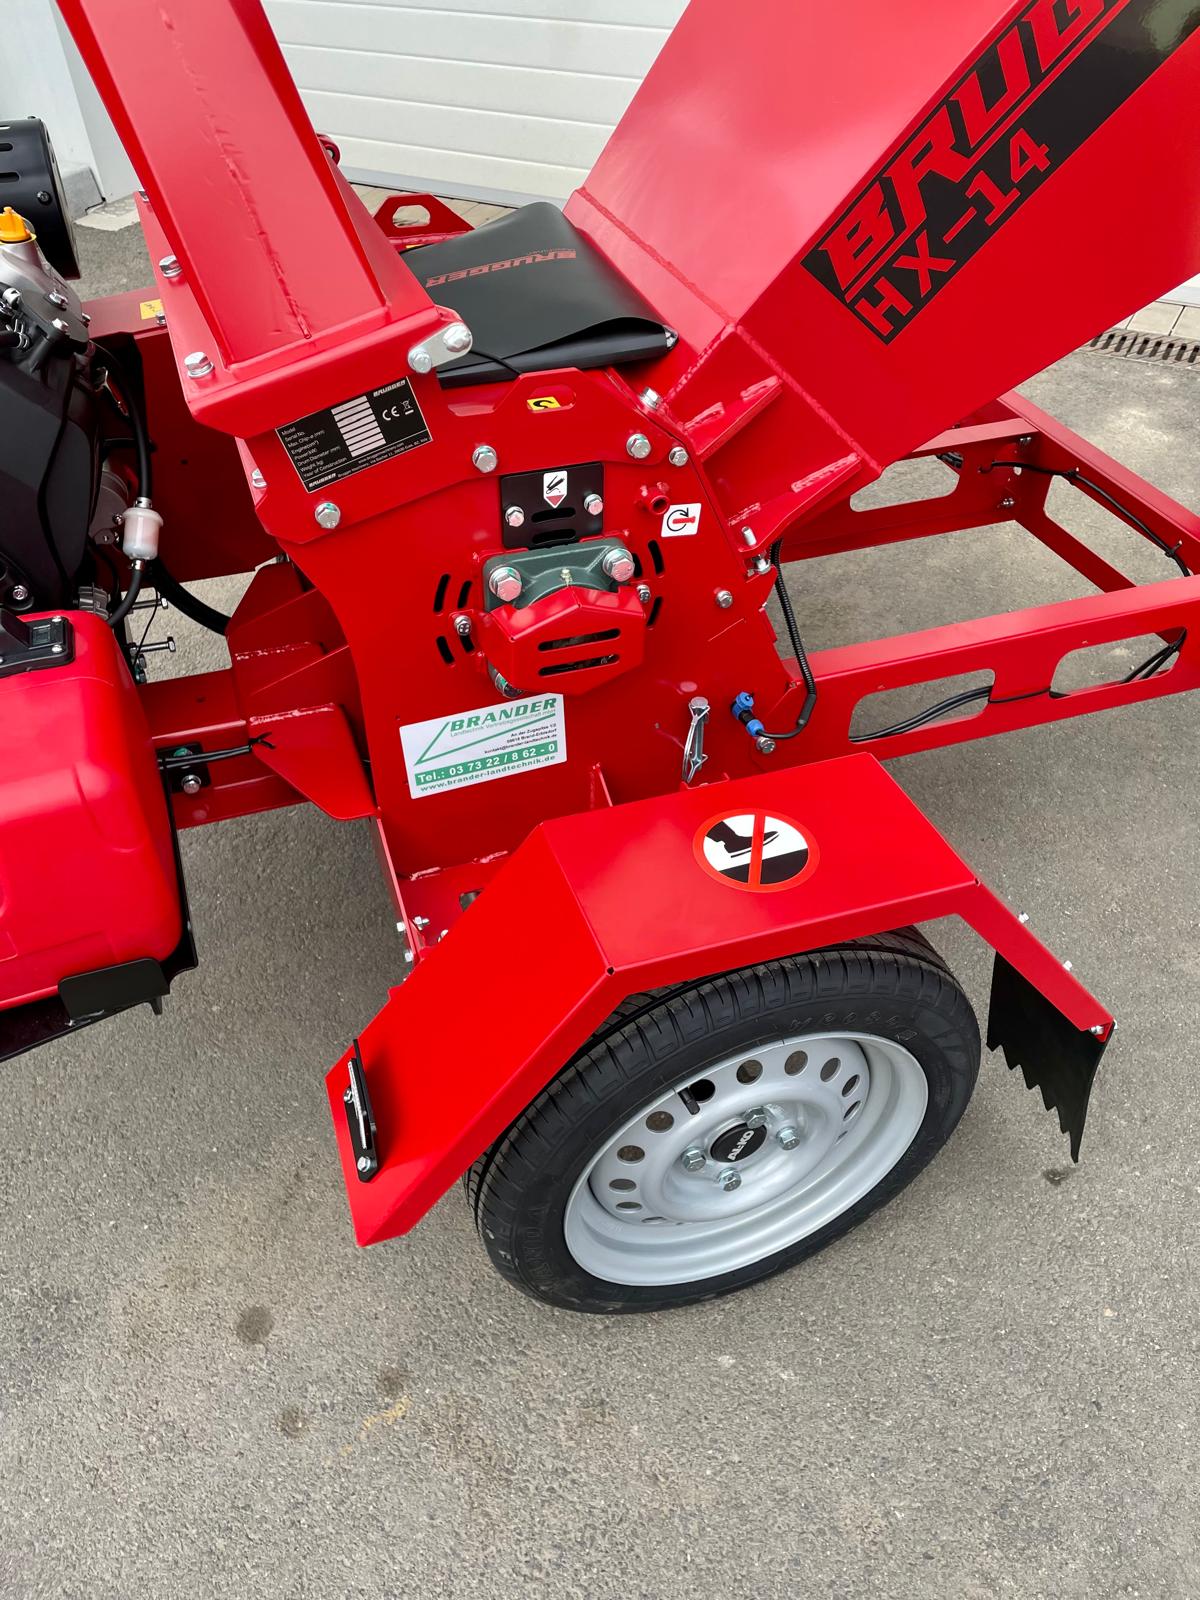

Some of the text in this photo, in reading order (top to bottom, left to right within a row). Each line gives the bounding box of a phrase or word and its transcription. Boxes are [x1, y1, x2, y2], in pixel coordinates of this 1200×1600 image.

[855, 127, 1050, 336] HX-14
[372, 379, 406, 397] BRUGGER
[281, 426, 295, 435] Model
[319, 455, 347, 471] Construction
[449, 697, 556, 731] BRANDER
[419, 770, 444, 783] Tel.:
[449, 765, 463, 775] 03
[467, 760, 481, 770] 73
[485, 756, 500, 766] 22
[511, 751, 518, 760] 8
[522, 747, 536, 757] 62
[548, 742, 554, 751] 0
[421, 755, 555, 792] www.brander-landtechnik.de
